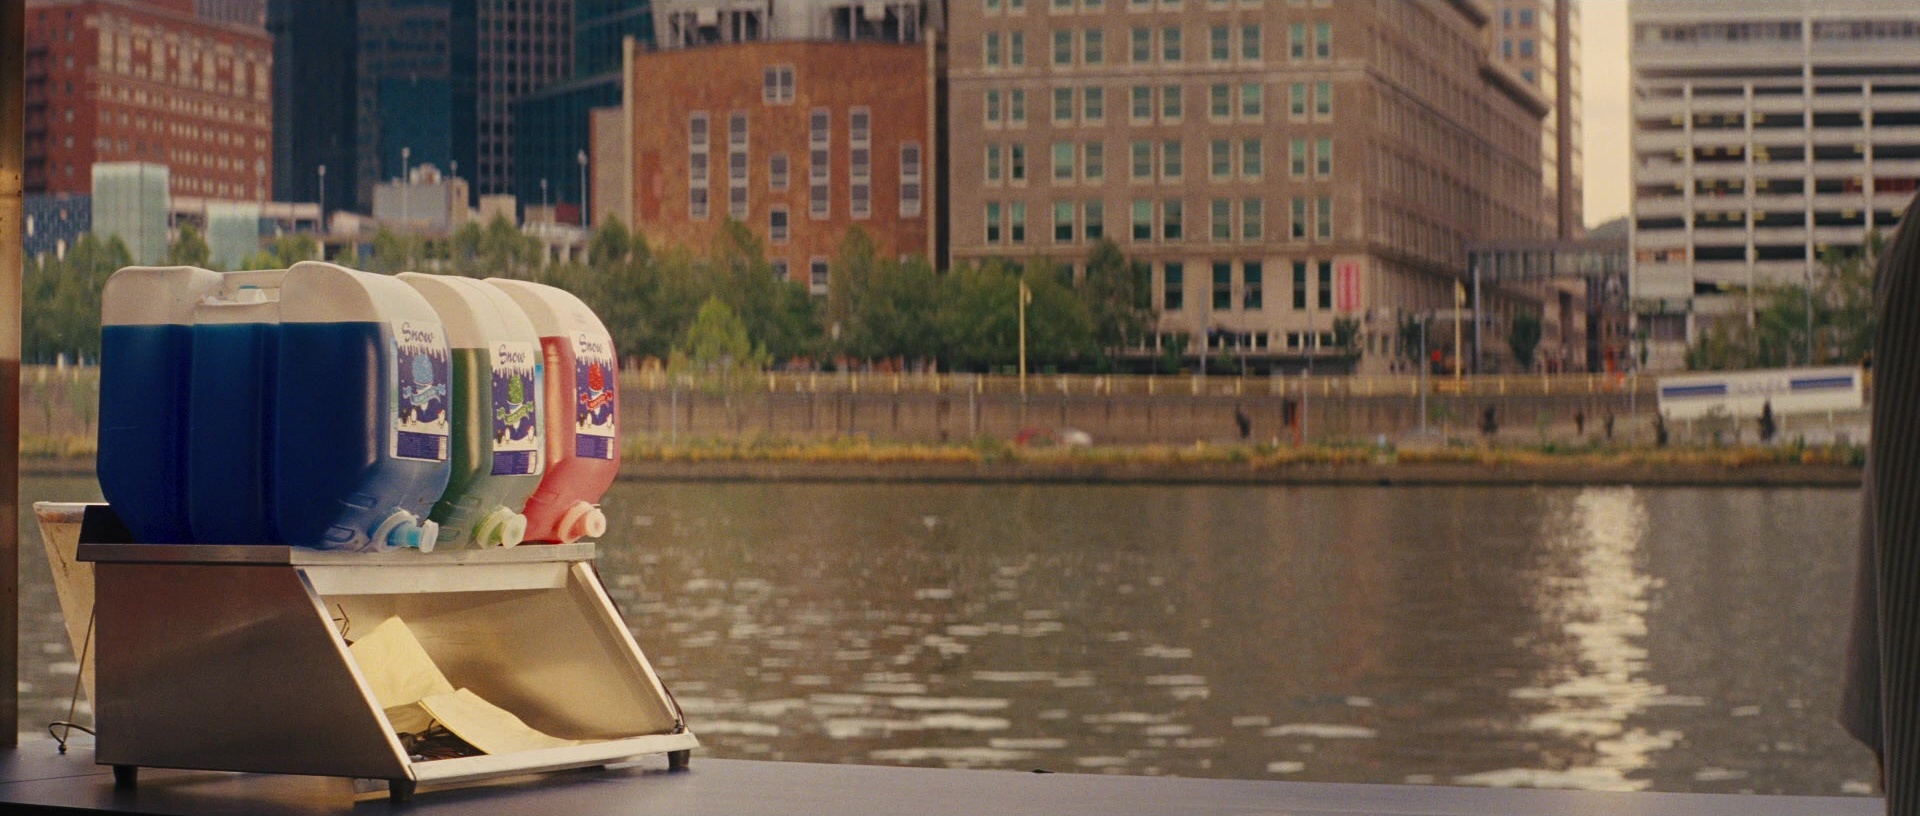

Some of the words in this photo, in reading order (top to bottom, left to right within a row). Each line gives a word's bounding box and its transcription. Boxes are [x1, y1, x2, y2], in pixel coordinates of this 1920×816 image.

[401, 322, 435, 343] Snow
[579, 334, 604, 353] Snow
[498, 344, 526, 364] Snow
